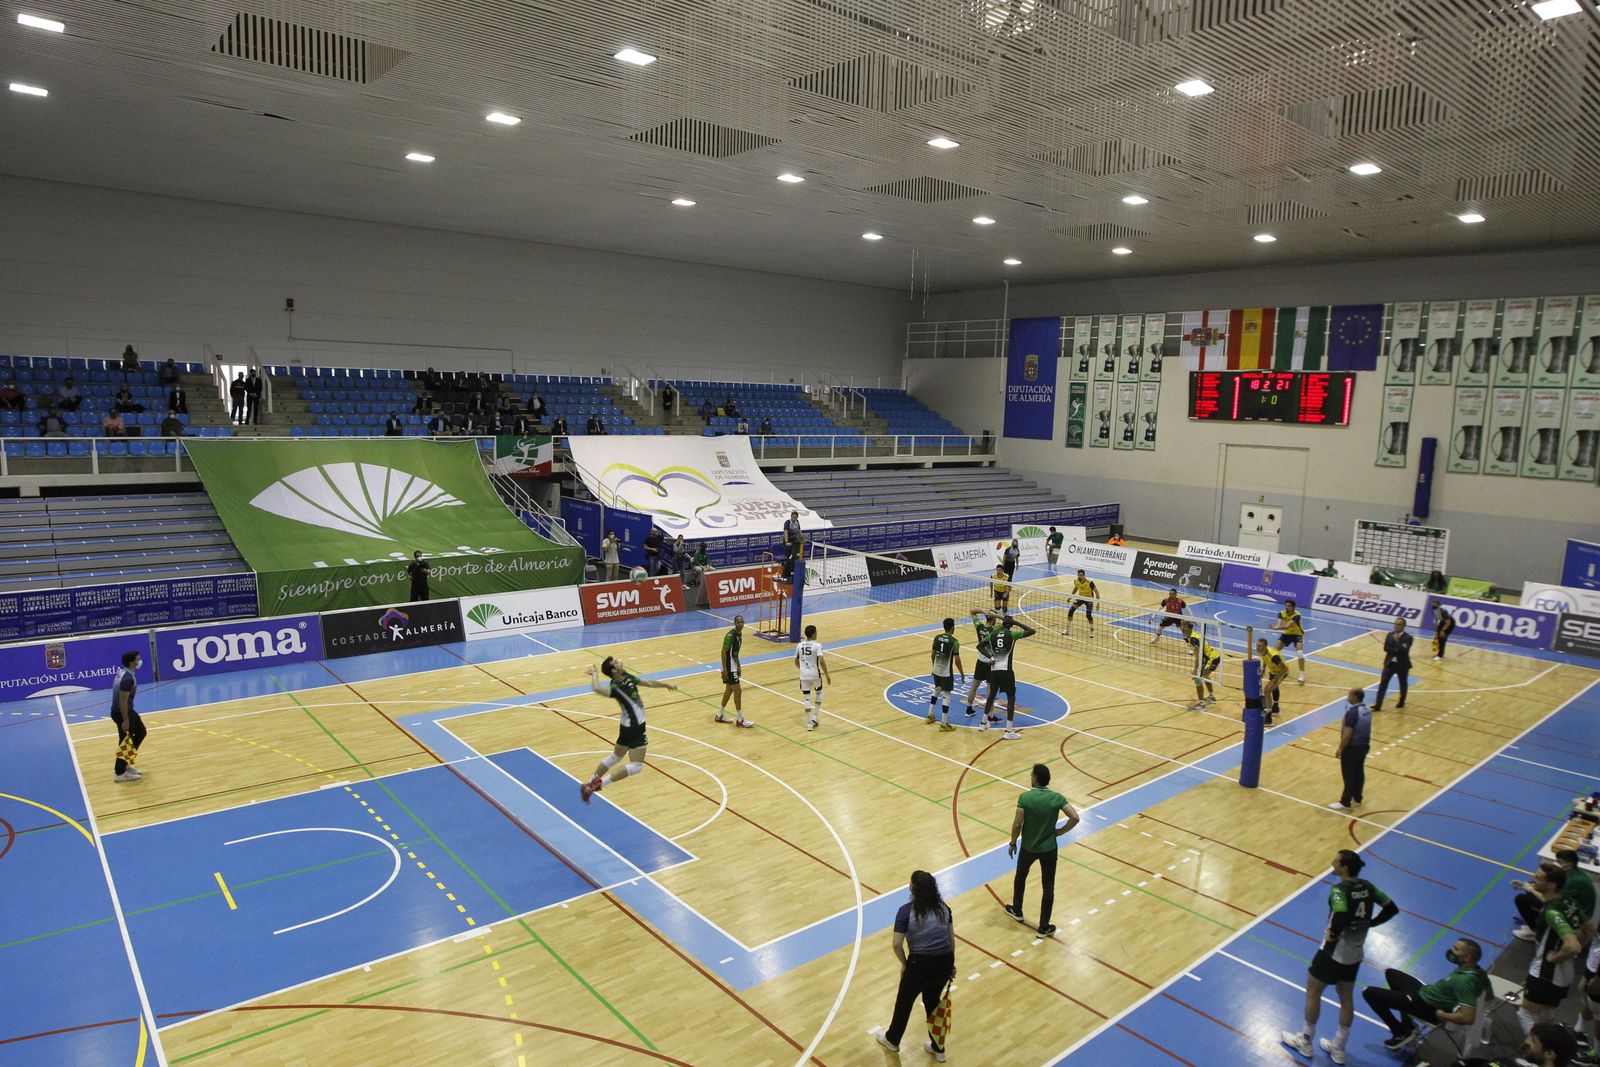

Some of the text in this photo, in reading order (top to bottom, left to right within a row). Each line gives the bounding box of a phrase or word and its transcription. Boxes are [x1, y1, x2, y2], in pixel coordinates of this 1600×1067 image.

[1008, 384, 1053, 393] DIPUTACIÓN
[1263, 381, 1270, 389] 2
[1276, 380, 1290, 390] 21
[1008, 393, 1051, 402] DE ALMERÍA
[1271, 395, 1278, 405] 0
[1187, 545, 1261, 562] Diario de Almería
[1143, 557, 1178, 571] Aprende
[278, 577, 354, 600] Siempre
[359, 573, 391, 588] con
[429, 563, 480, 585] eporte
[484, 559, 504, 574] de
[506, 557, 573, 572] Almería
[847, 573, 868, 582] Banco
[1150, 569, 1176, 579] comer
[718, 576, 755, 595] SVM
[1233, 582, 1264, 592] DIPUTACIÓN
[1273, 589, 1297, 598] ALMERÍA
[596, 589, 639, 610] SVM
[720, 595, 738, 605] SUPERLIGA
[1315, 593, 1421, 619] alcazaba
[502, 608, 578, 626] Unicaja Banco
[597, 604, 660, 619] SUPERLIGA VOLEIBOL MASCULINA
[406, 621, 456, 636] ALMERÍA
[801, 647, 812, 655] 15
[997, 639, 1004, 648] 6
[61, 673, 75, 682] DE
[78, 665, 122, 679] ALMERÍA
[1355, 901, 1365, 918] 4
